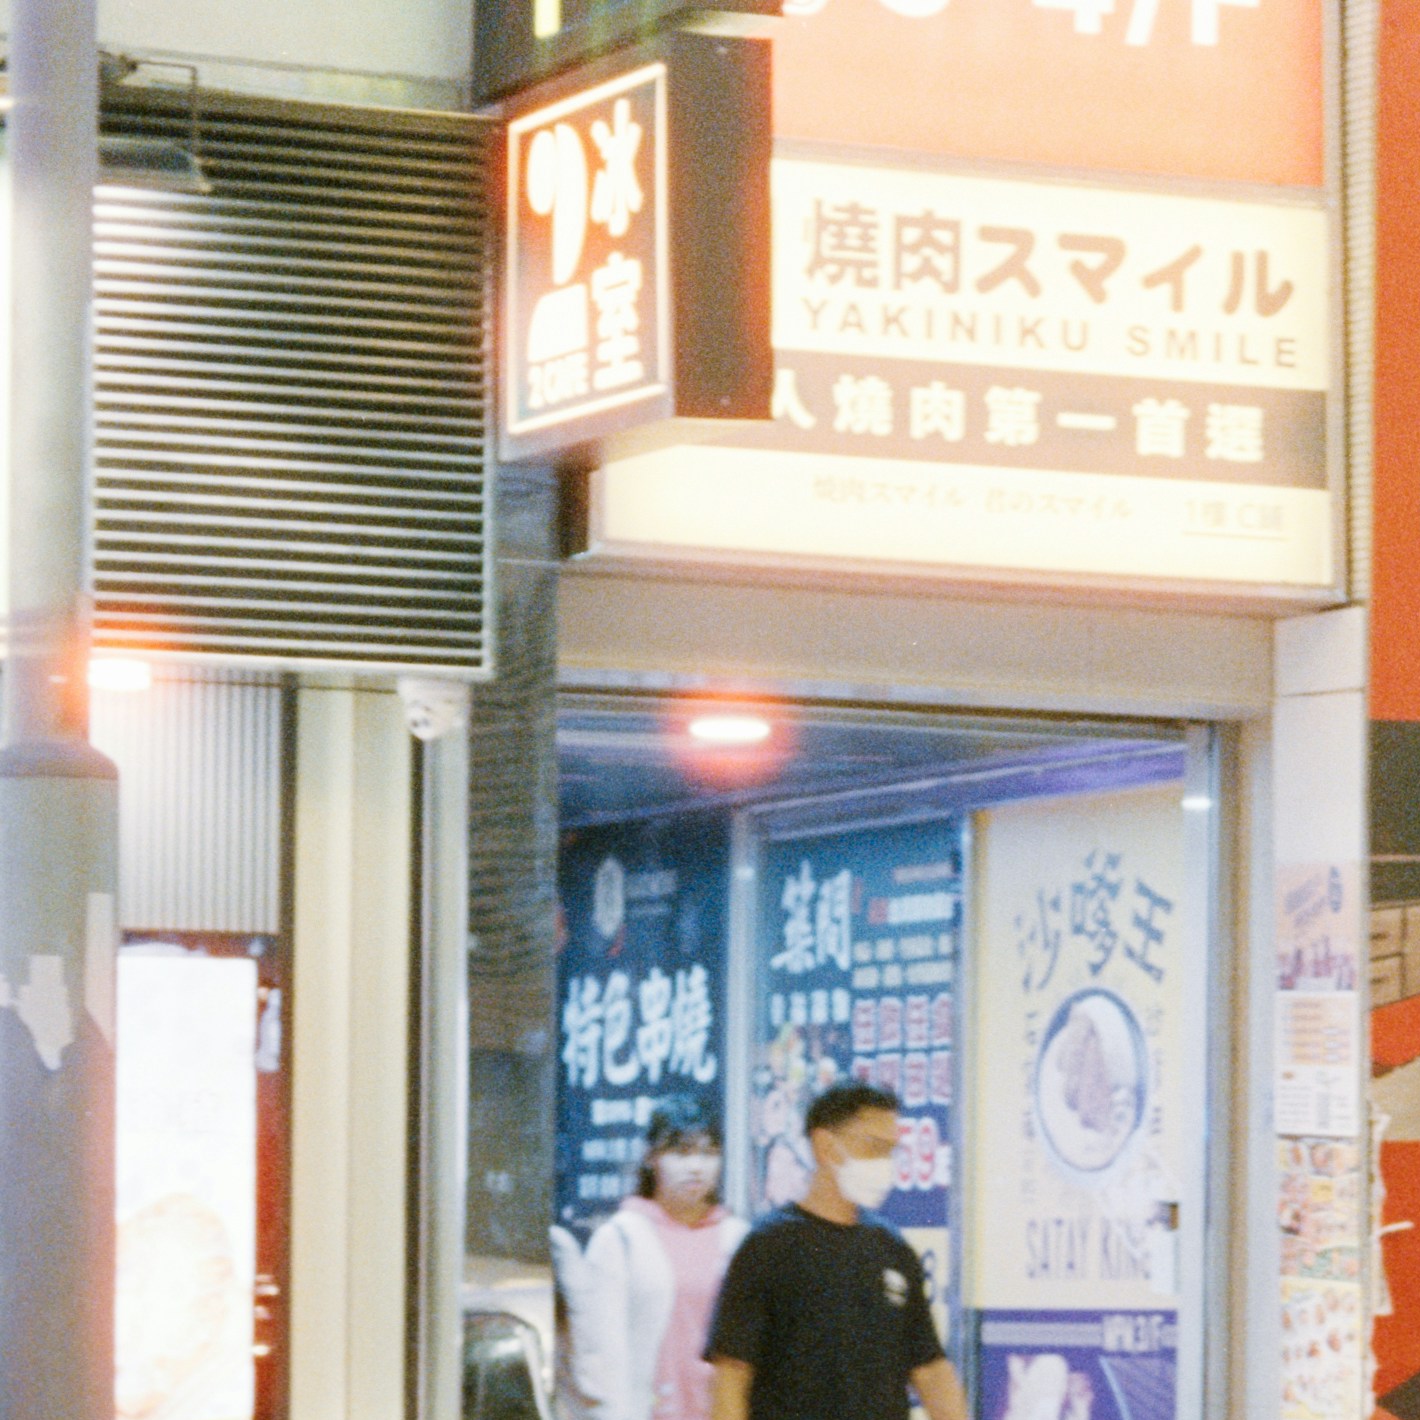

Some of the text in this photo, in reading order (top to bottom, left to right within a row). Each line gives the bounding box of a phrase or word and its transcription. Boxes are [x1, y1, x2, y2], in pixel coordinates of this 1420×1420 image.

[802, 298, 1298, 369] YAKINIKU SMILE
[1027, 1213, 1090, 1281] SATAY
